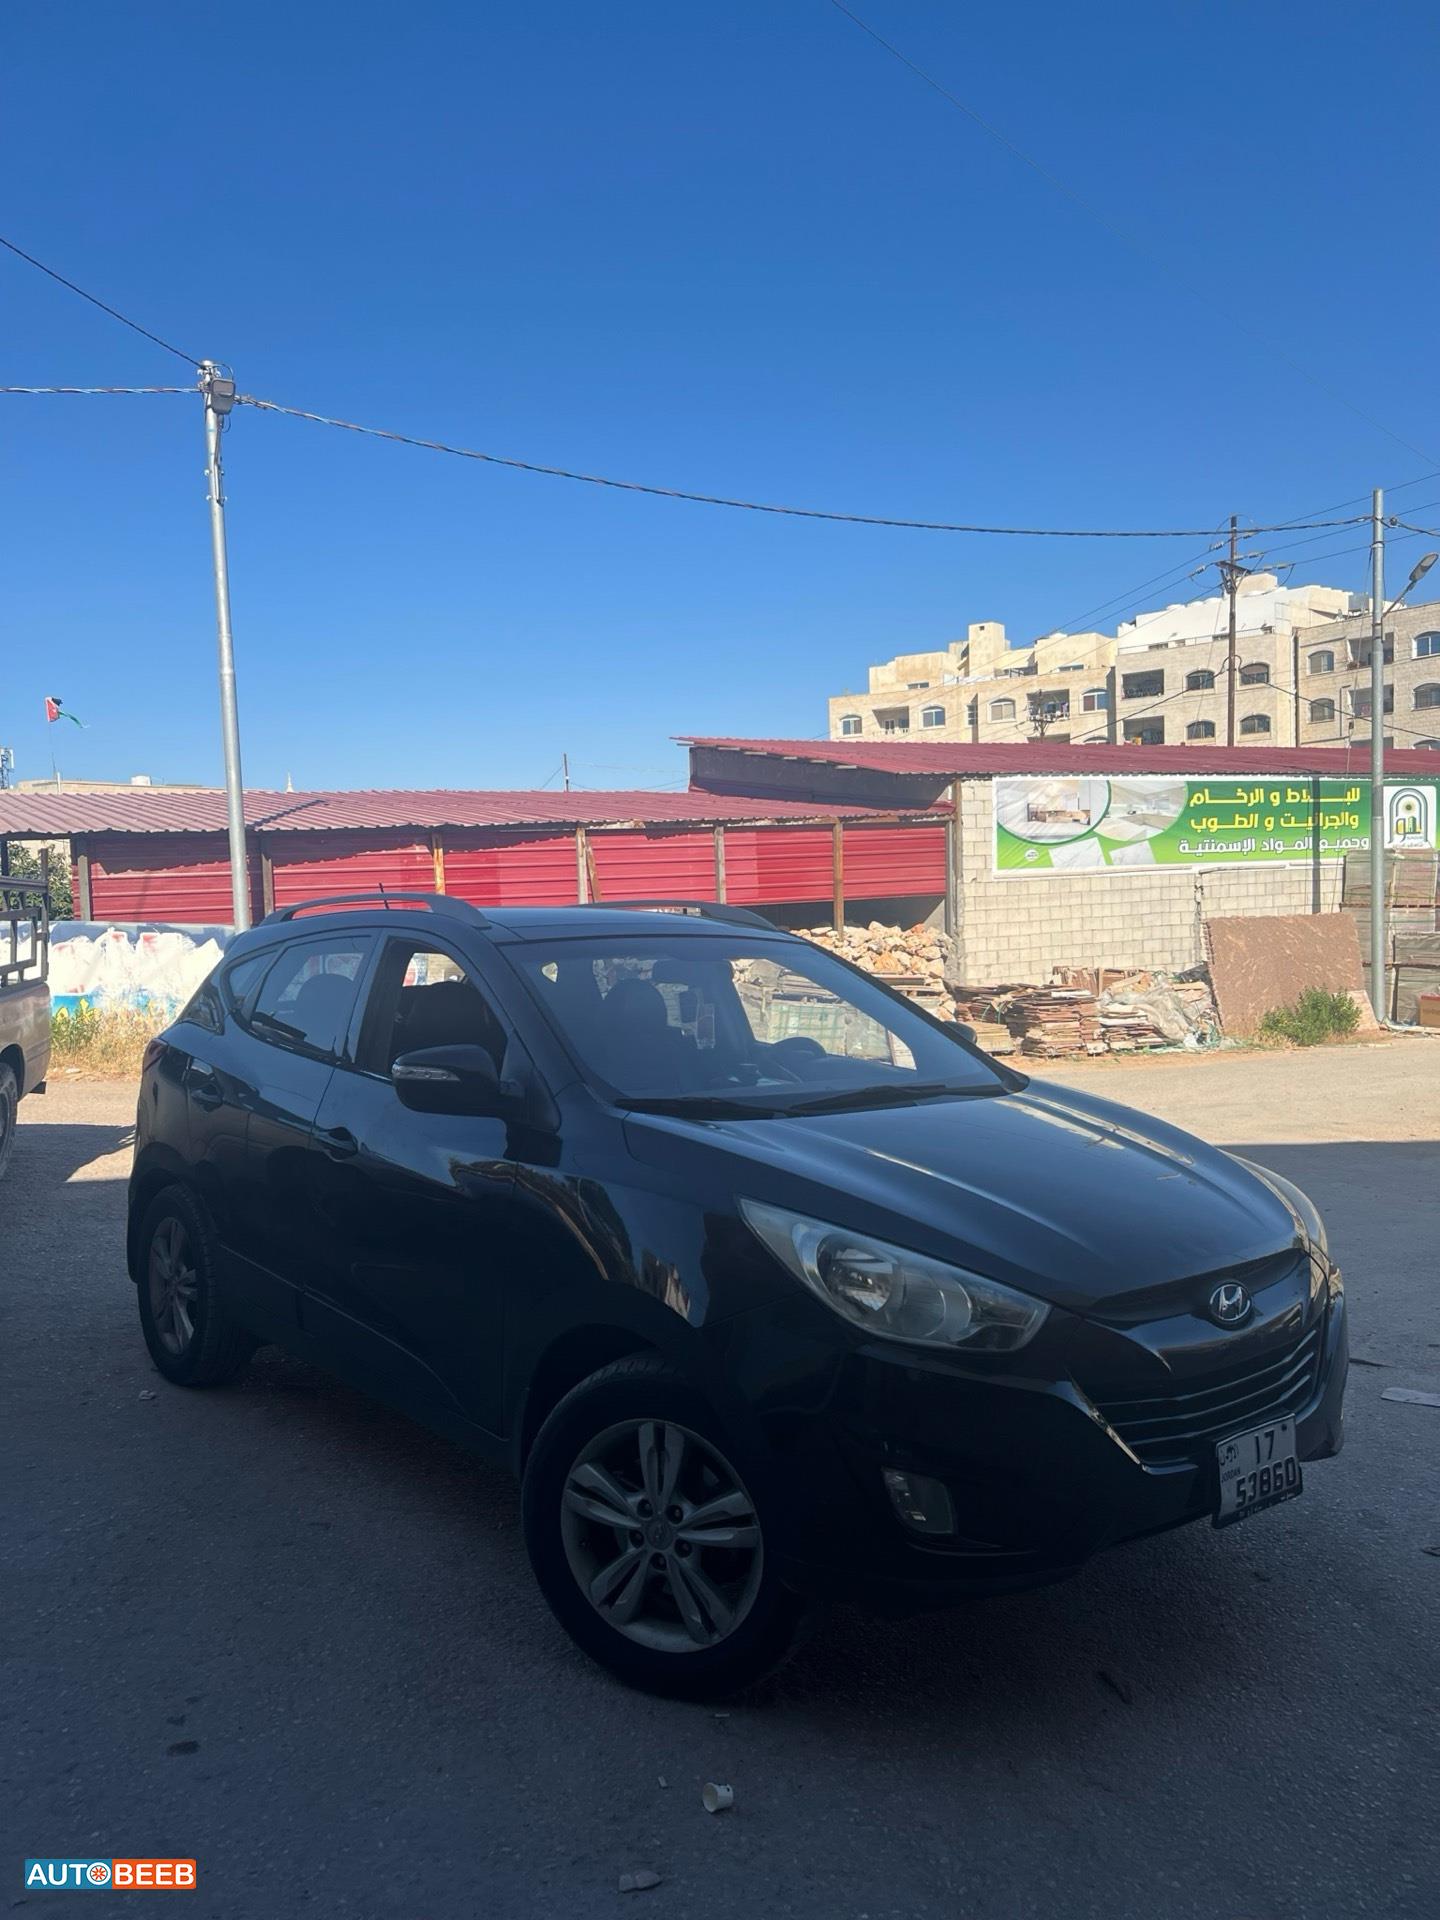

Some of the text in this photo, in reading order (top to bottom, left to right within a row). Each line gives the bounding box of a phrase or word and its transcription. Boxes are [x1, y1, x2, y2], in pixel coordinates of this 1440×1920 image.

[1189, 787, 1360, 807] للبلاط و الرخام
[1190, 811, 1359, 833] والجرانيت و الطوب
[1261, 836, 1312, 853] المواد
[1253, 1429, 1275, 1465] 17
[1236, 1456, 1297, 1508] 53860
